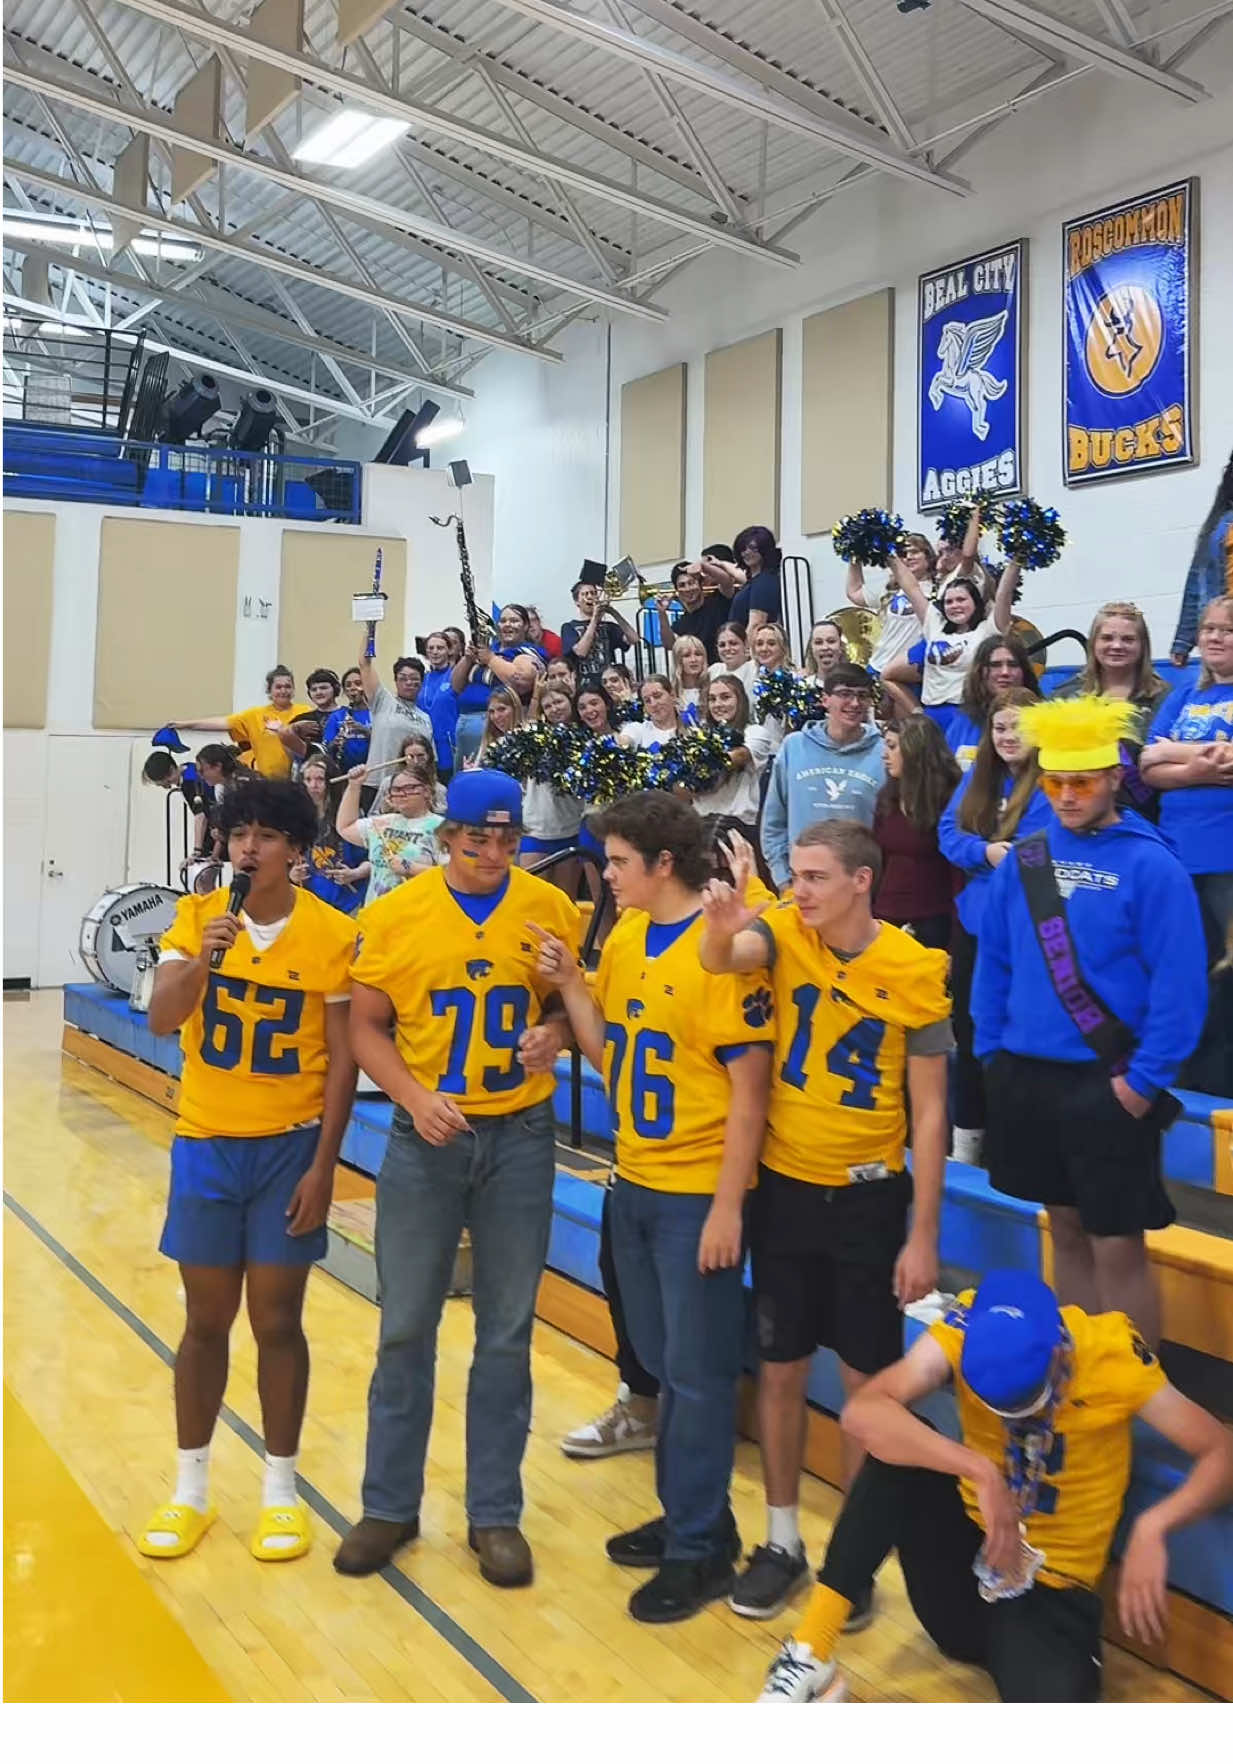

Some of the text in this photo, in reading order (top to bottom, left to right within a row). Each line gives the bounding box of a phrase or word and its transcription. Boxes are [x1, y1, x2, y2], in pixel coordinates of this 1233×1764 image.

[1069, 195, 1184, 273] ROSCOMMON
[923, 253, 1016, 313] BEAL CITY
[923, 450, 1015, 501] AGGIES
[1068, 404, 1184, 472] BUCKS
[120, 893, 164, 921] YAMAHA
[199, 970, 306, 1076] 62
[428, 984, 531, 1096] 79
[780, 981, 889, 1111] 14
[603, 1020, 676, 1141] 76
